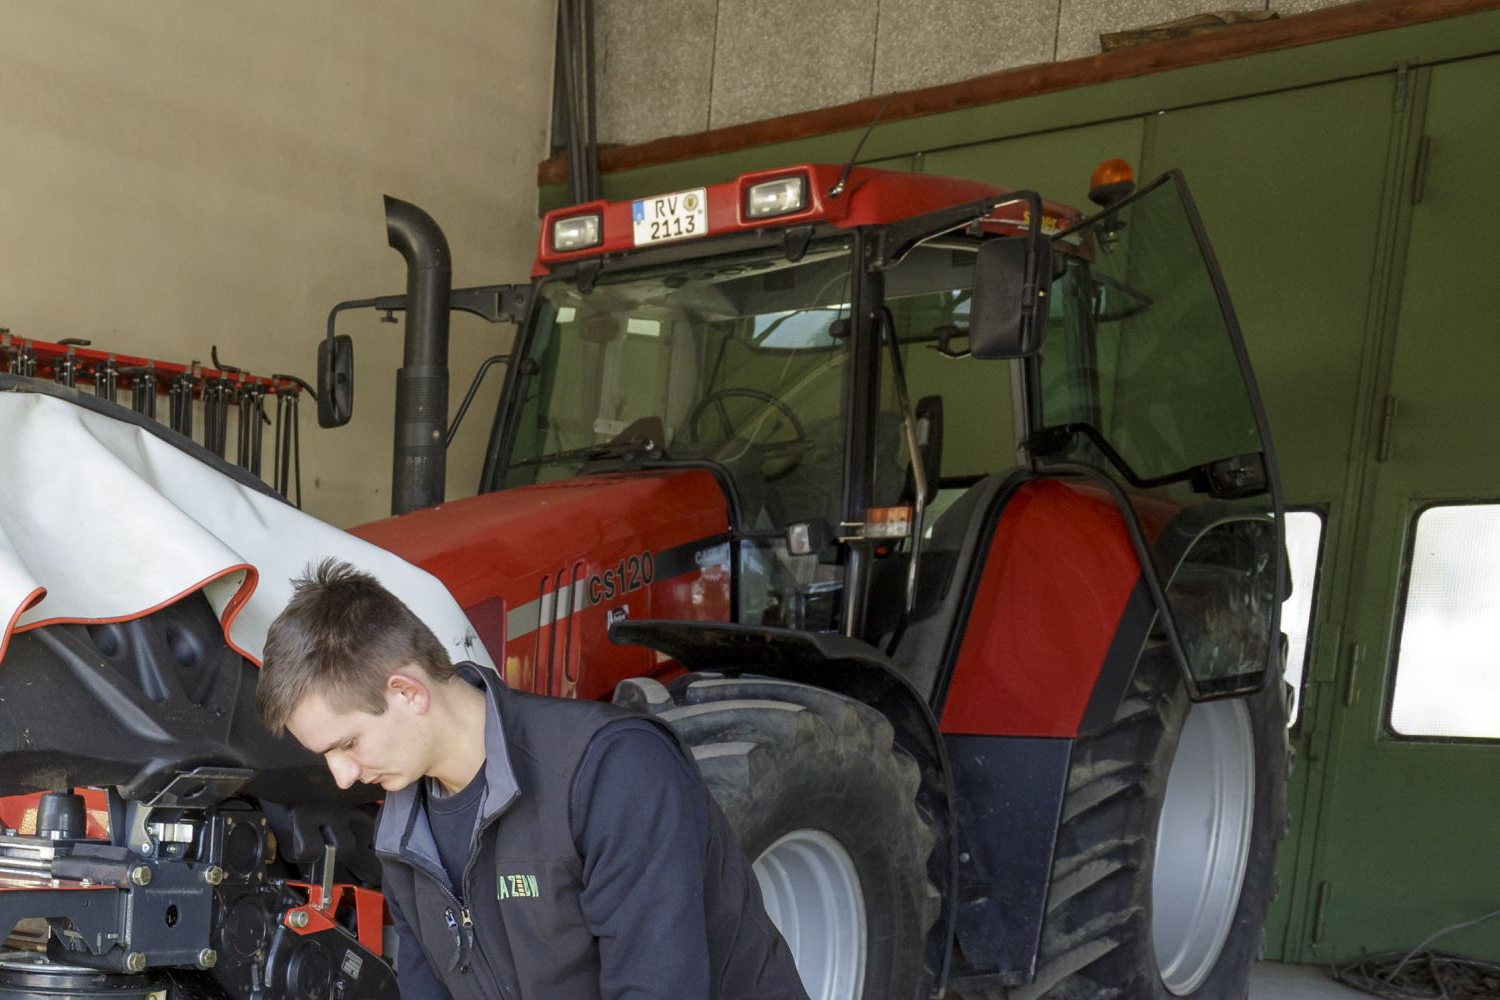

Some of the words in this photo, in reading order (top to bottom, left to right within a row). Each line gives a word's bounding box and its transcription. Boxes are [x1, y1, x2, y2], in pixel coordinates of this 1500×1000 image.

[655, 195, 678, 219] RV
[650, 215, 696, 240] 2113
[588, 550, 654, 606] CS120
